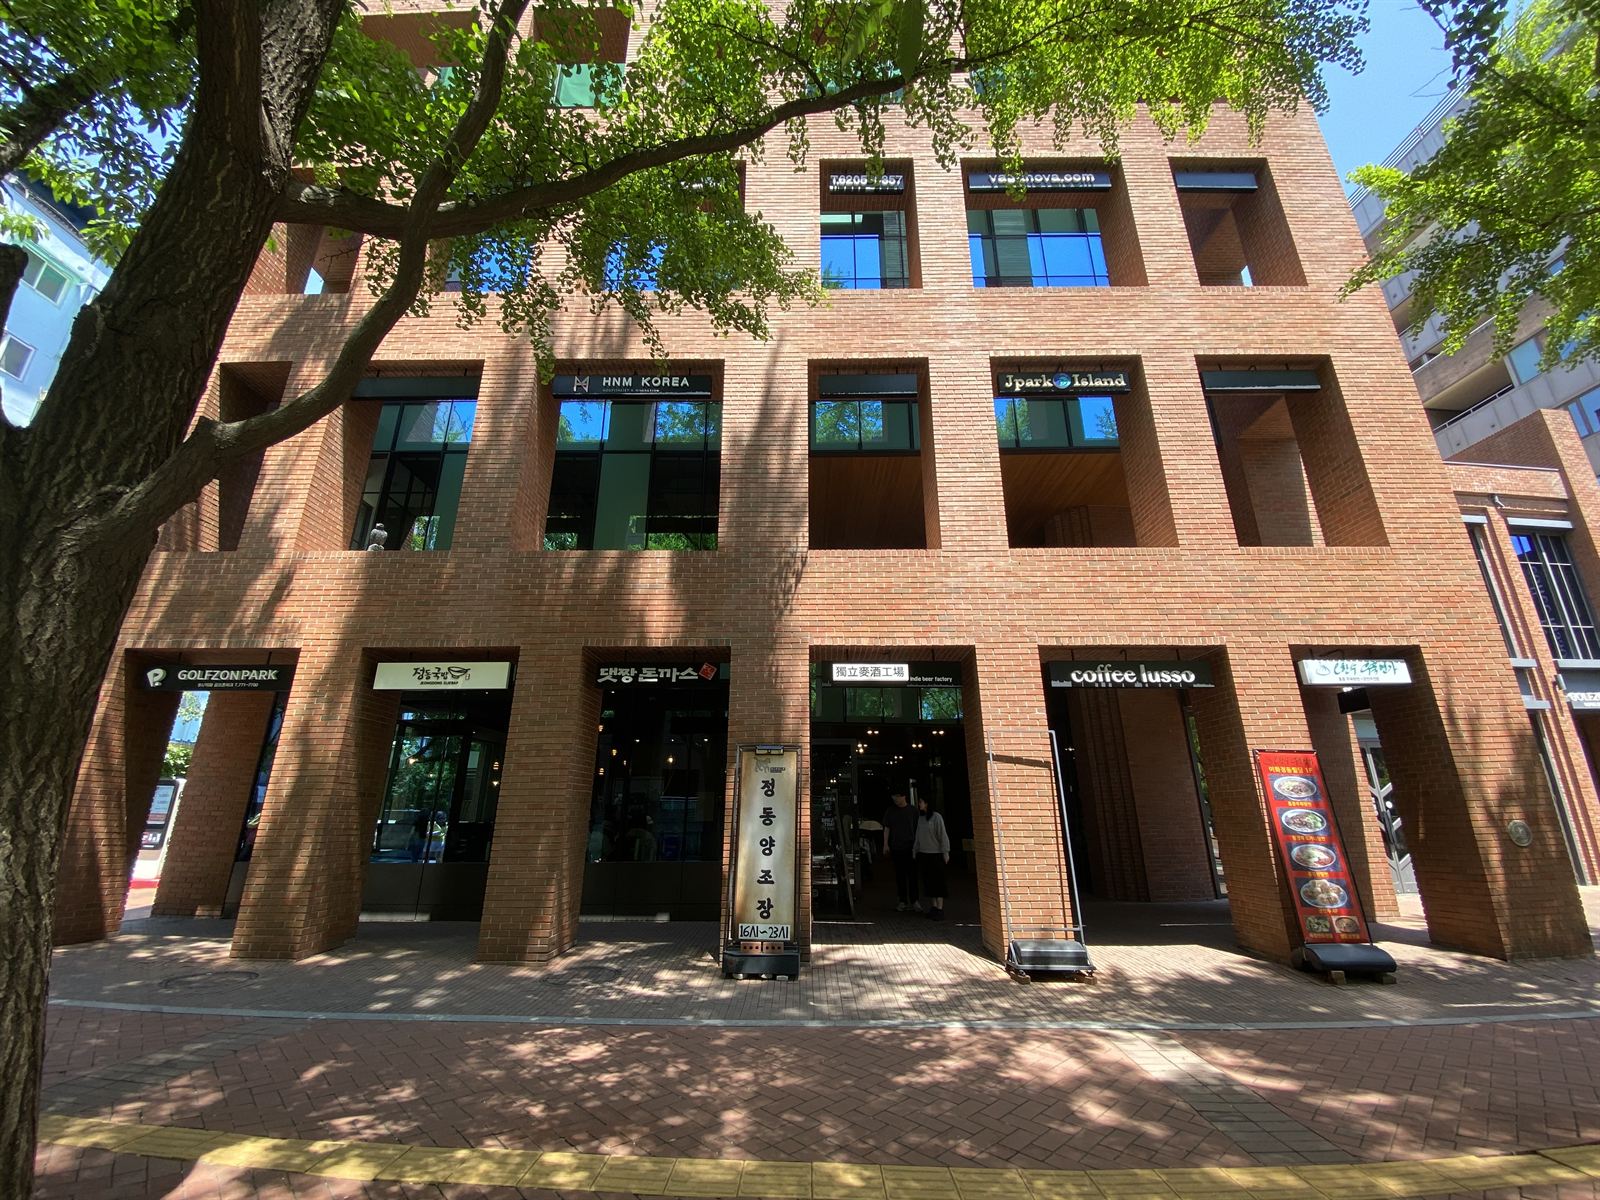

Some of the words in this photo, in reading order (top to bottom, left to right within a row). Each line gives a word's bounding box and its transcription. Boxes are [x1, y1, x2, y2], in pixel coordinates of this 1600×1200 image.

[602, 376, 632, 387] HNM
[641, 376, 690, 387] KOREA
[1005, 374, 1053, 391] Jpark
[1072, 373, 1126, 387] Island
[1070, 664, 1137, 683] coffee
[1139, 664, 1196, 683] lusso
[756, 778, 776, 920] 정동양조장
